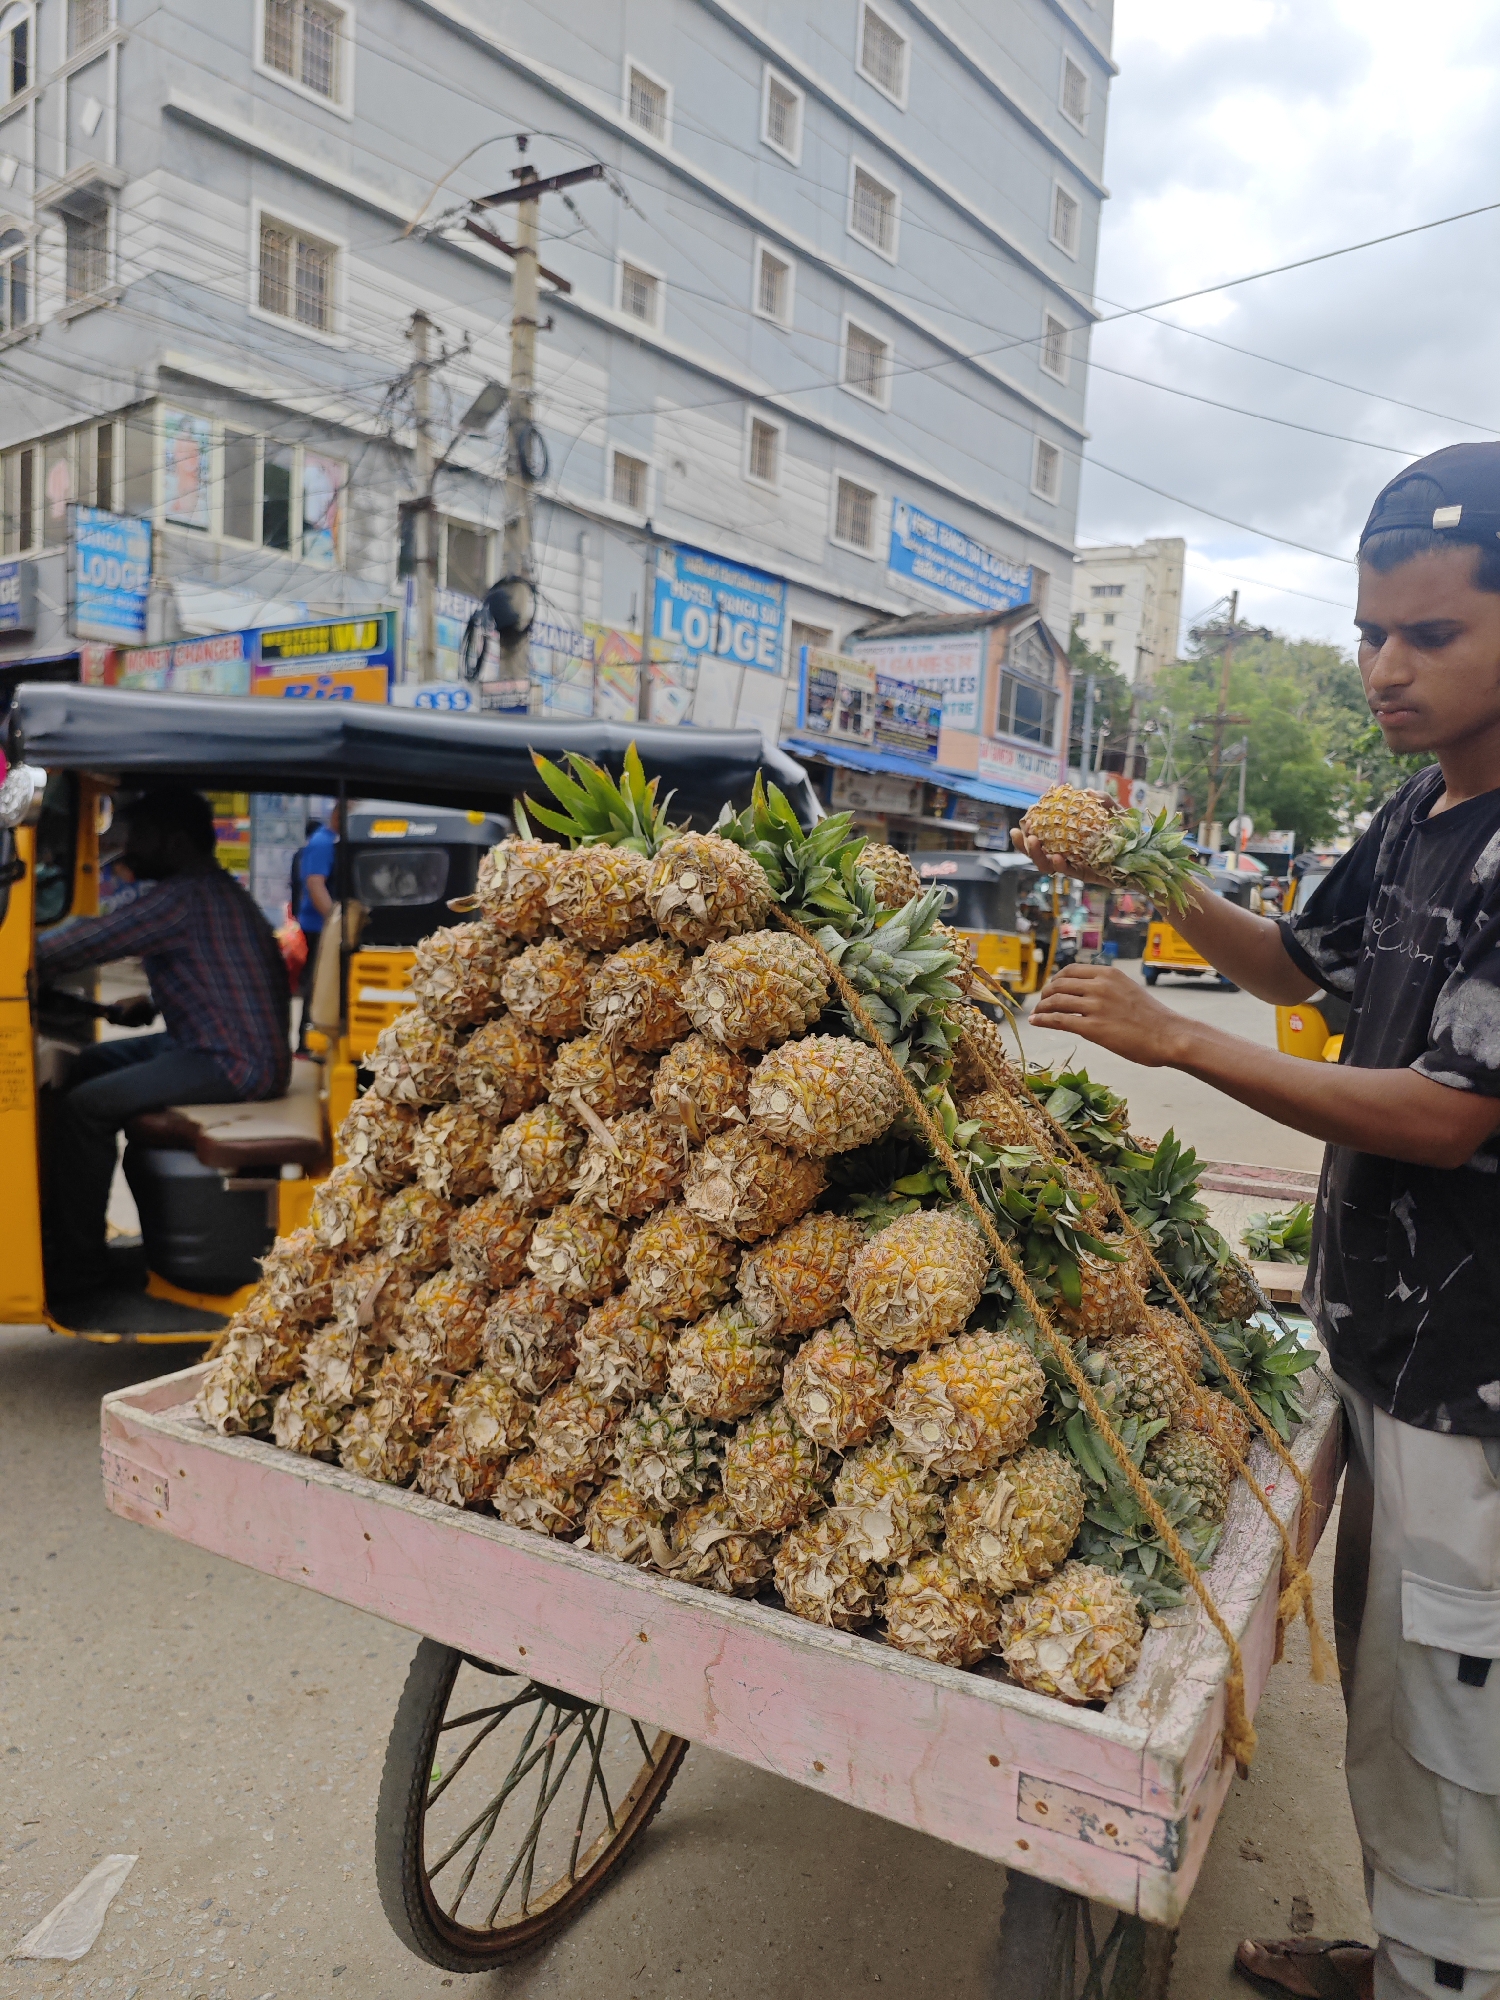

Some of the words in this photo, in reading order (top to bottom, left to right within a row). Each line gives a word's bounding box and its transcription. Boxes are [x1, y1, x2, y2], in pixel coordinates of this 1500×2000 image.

[77, 551, 148, 593] LODGE
[981, 549, 1030, 588] LODGE
[280, 641, 329, 658] UNION
[661, 598, 778, 668] LODGE
[125, 649, 170, 674] MONEY
[174, 634, 241, 668] CHANGER
[889, 654, 974, 675] GANESH
